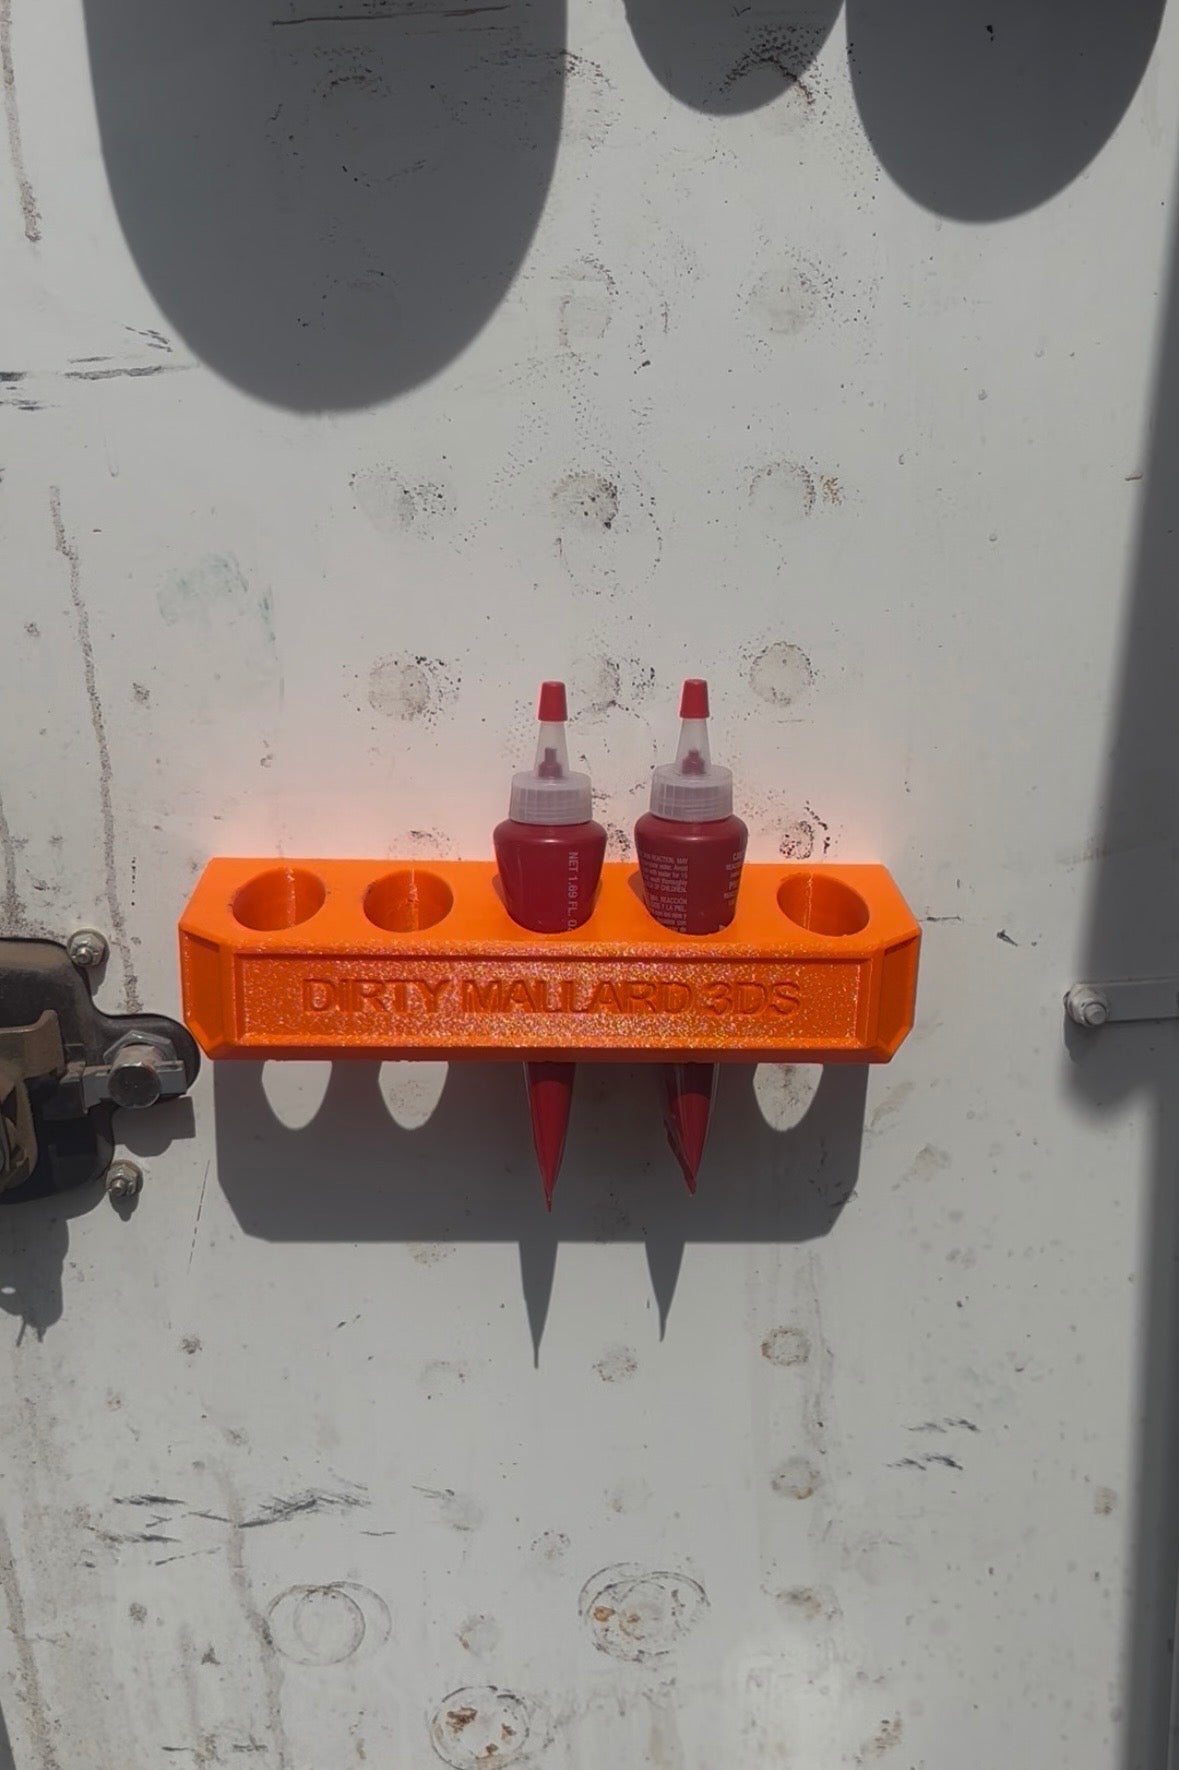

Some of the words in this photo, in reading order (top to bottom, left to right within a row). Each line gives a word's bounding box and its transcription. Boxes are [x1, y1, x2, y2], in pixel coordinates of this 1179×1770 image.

[567, 851, 580, 872] NET
[567, 876, 579, 899] 1.69
[302, 979, 451, 1013] DIRTY
[461, 980, 693, 1014] MALLARD
[702, 981, 801, 1015] 3DS
